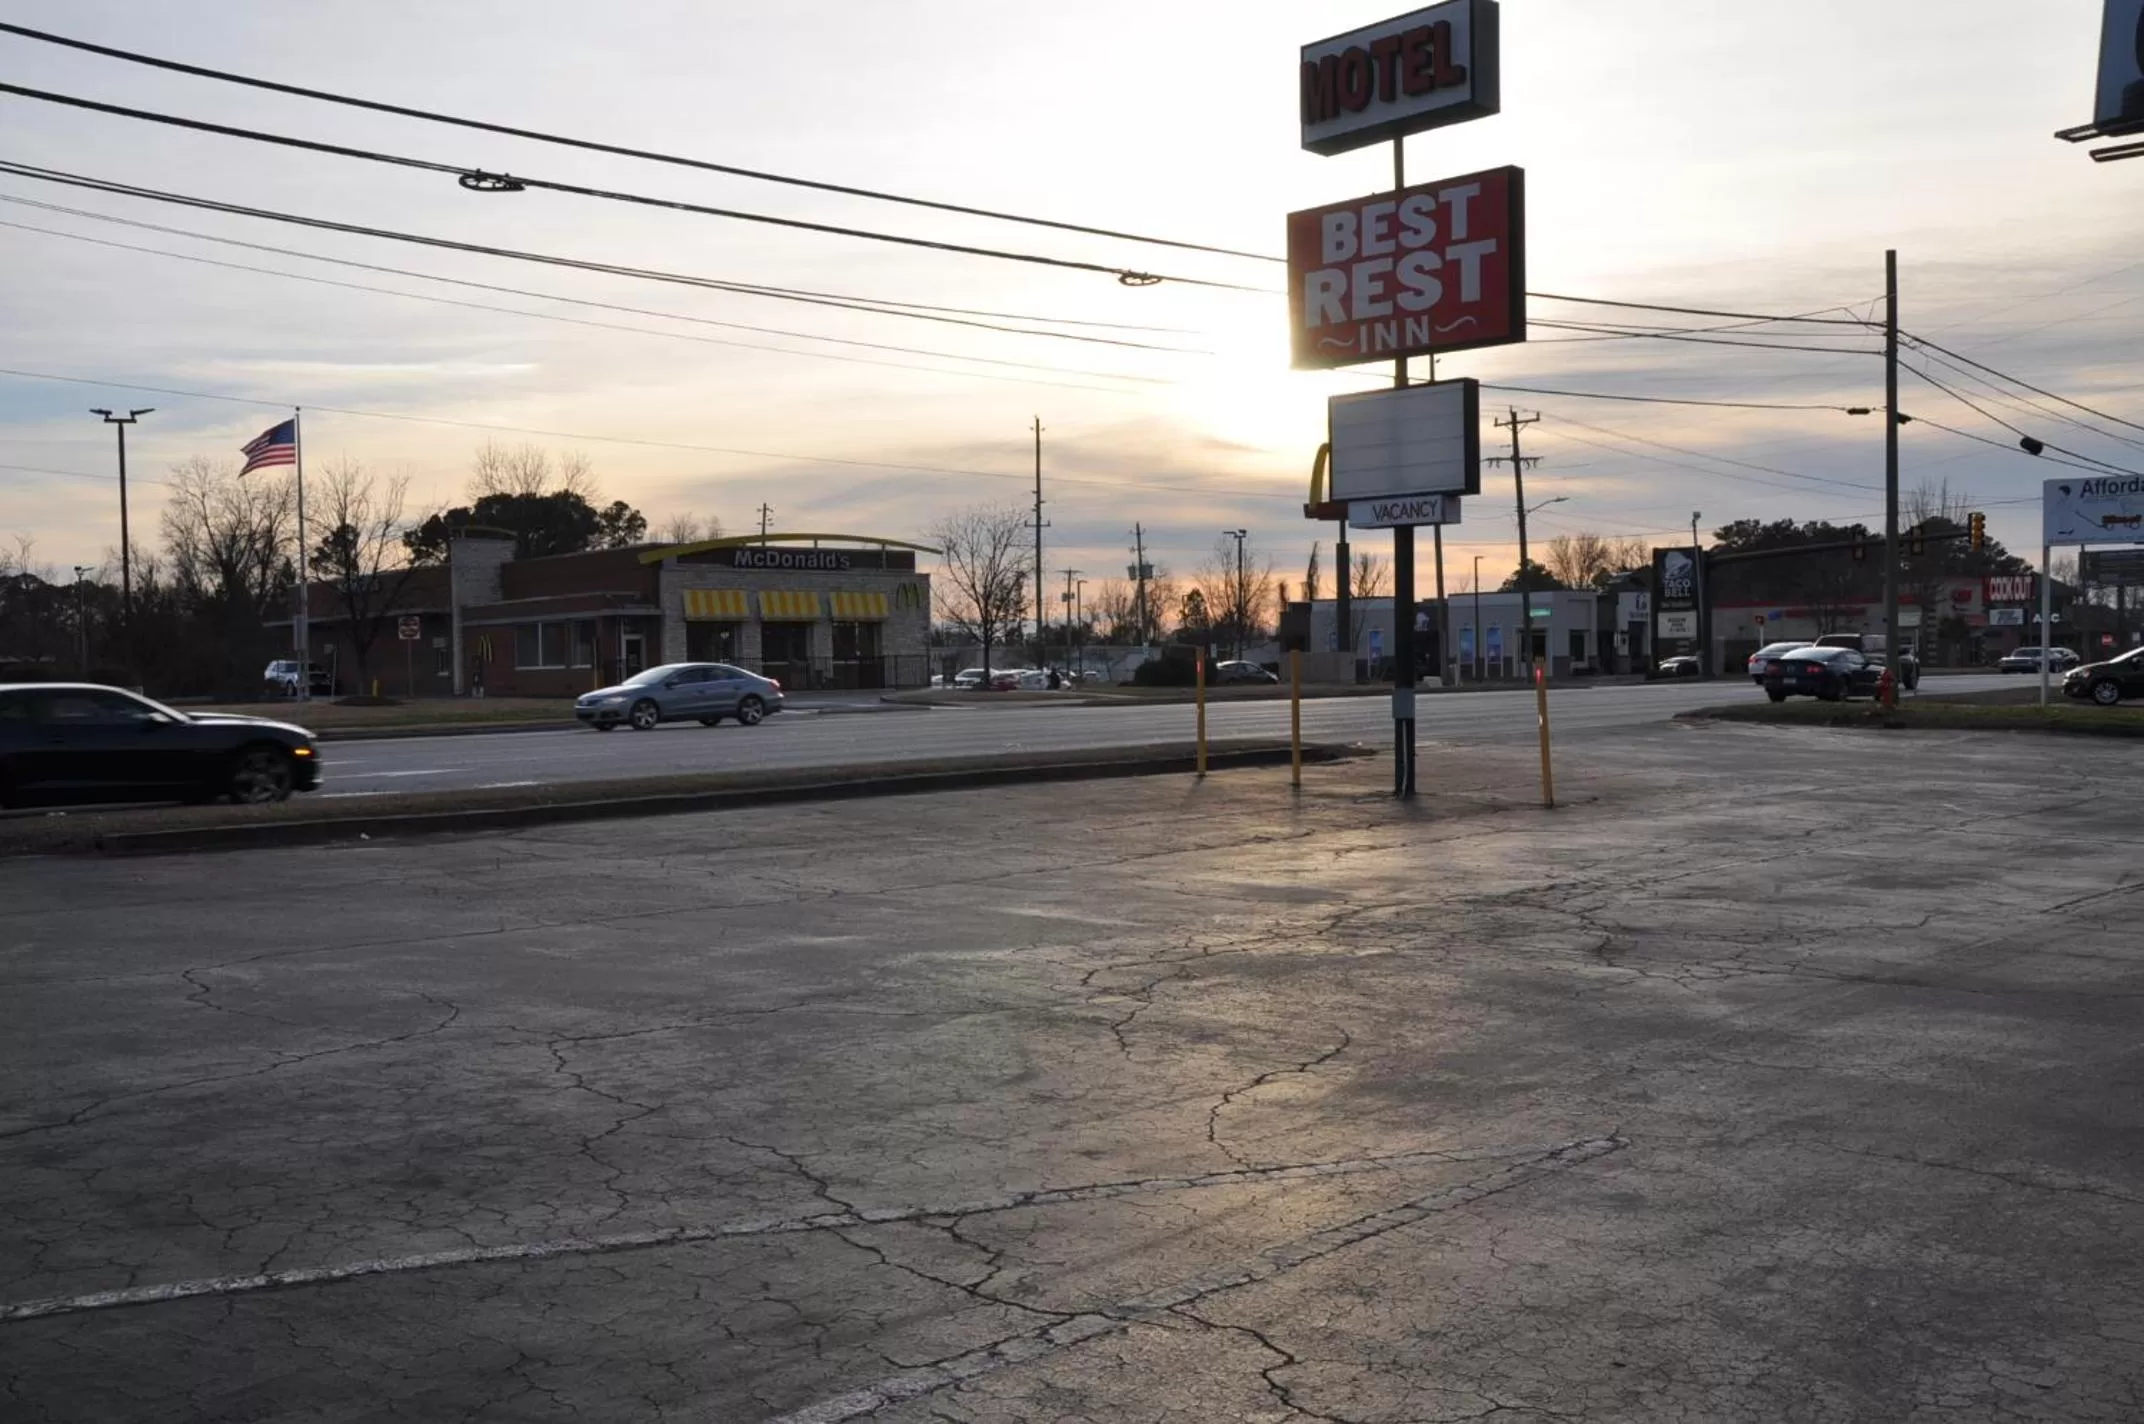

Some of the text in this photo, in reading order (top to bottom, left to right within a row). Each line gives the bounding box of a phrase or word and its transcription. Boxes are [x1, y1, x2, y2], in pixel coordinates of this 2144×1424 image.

[1302, 19, 1467, 125] MOTEL
[1321, 183, 1481, 264] BEST
[1304, 238, 1497, 328] REST
[1358, 315, 1430, 353] INN
[1372, 501, 1438, 522] VACANCY
[734, 549, 850, 569] McDonald's
[1664, 579, 1691, 588] TACO
[1989, 576, 2013, 601] COOK
[2014, 576, 2033, 601] OUT
